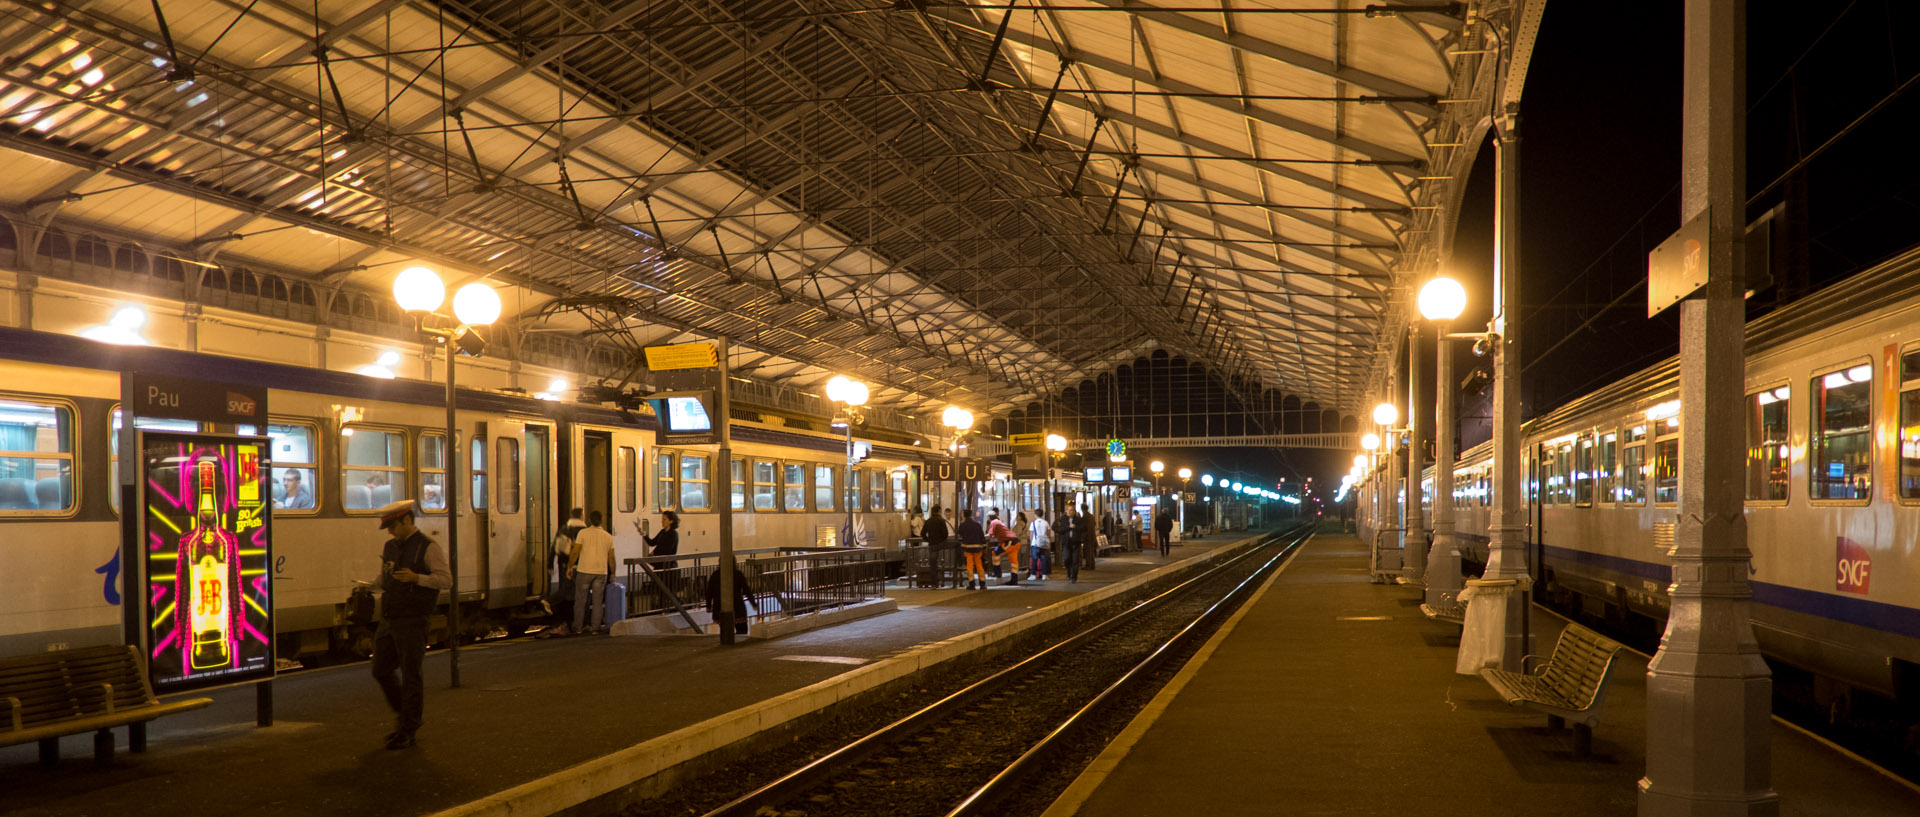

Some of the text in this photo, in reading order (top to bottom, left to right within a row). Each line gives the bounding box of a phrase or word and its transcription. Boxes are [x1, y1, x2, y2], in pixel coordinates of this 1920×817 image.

[1886, 353, 1894, 390] 1
[148, 385, 179, 408] Pau
[227, 400, 255, 413] SNCF
[652, 449, 658, 464] 2
[1119, 487, 1130, 497] 2V
[1837, 558, 1870, 587] SNCF
[197, 579, 222, 616] J&B
